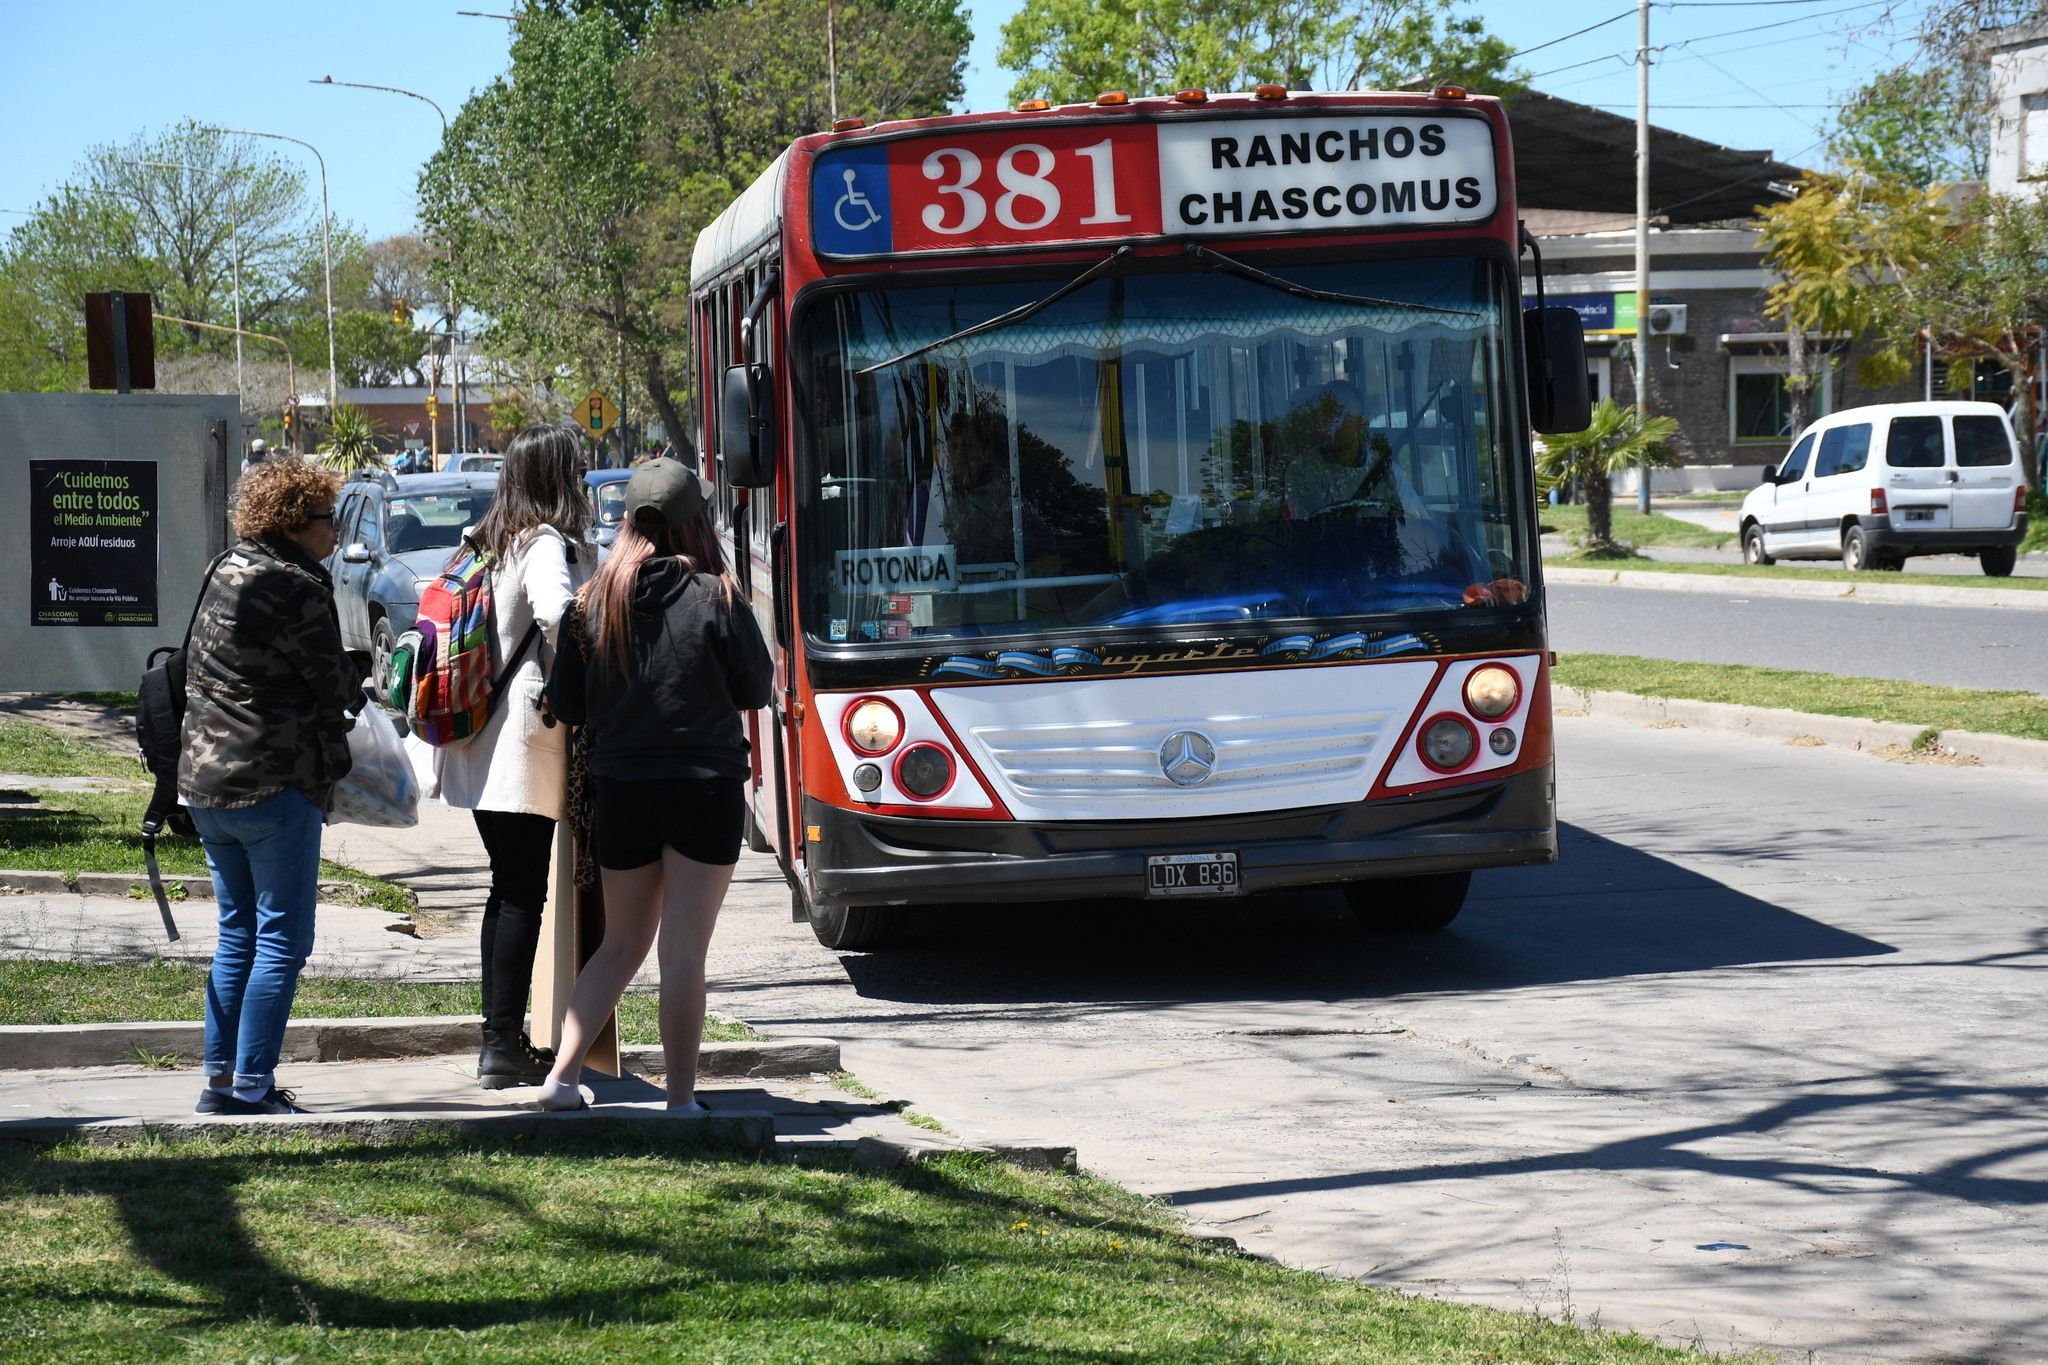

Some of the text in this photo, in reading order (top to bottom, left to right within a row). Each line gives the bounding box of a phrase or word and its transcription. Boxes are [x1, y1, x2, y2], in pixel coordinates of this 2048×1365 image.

[1211, 123, 1446, 169] RANCHOS
[920, 137, 1132, 236] 381
[1179, 177, 1483, 225] CHASCOMUS
[53, 492, 140, 510] entre todos
[54, 513, 63, 525] el
[64, 513, 93, 526] Medio
[51, 534, 136, 549] Arroje AQUÍ residuos
[841, 553, 950, 586] ROTONDA
[1153, 863, 1234, 887] LDX 836
